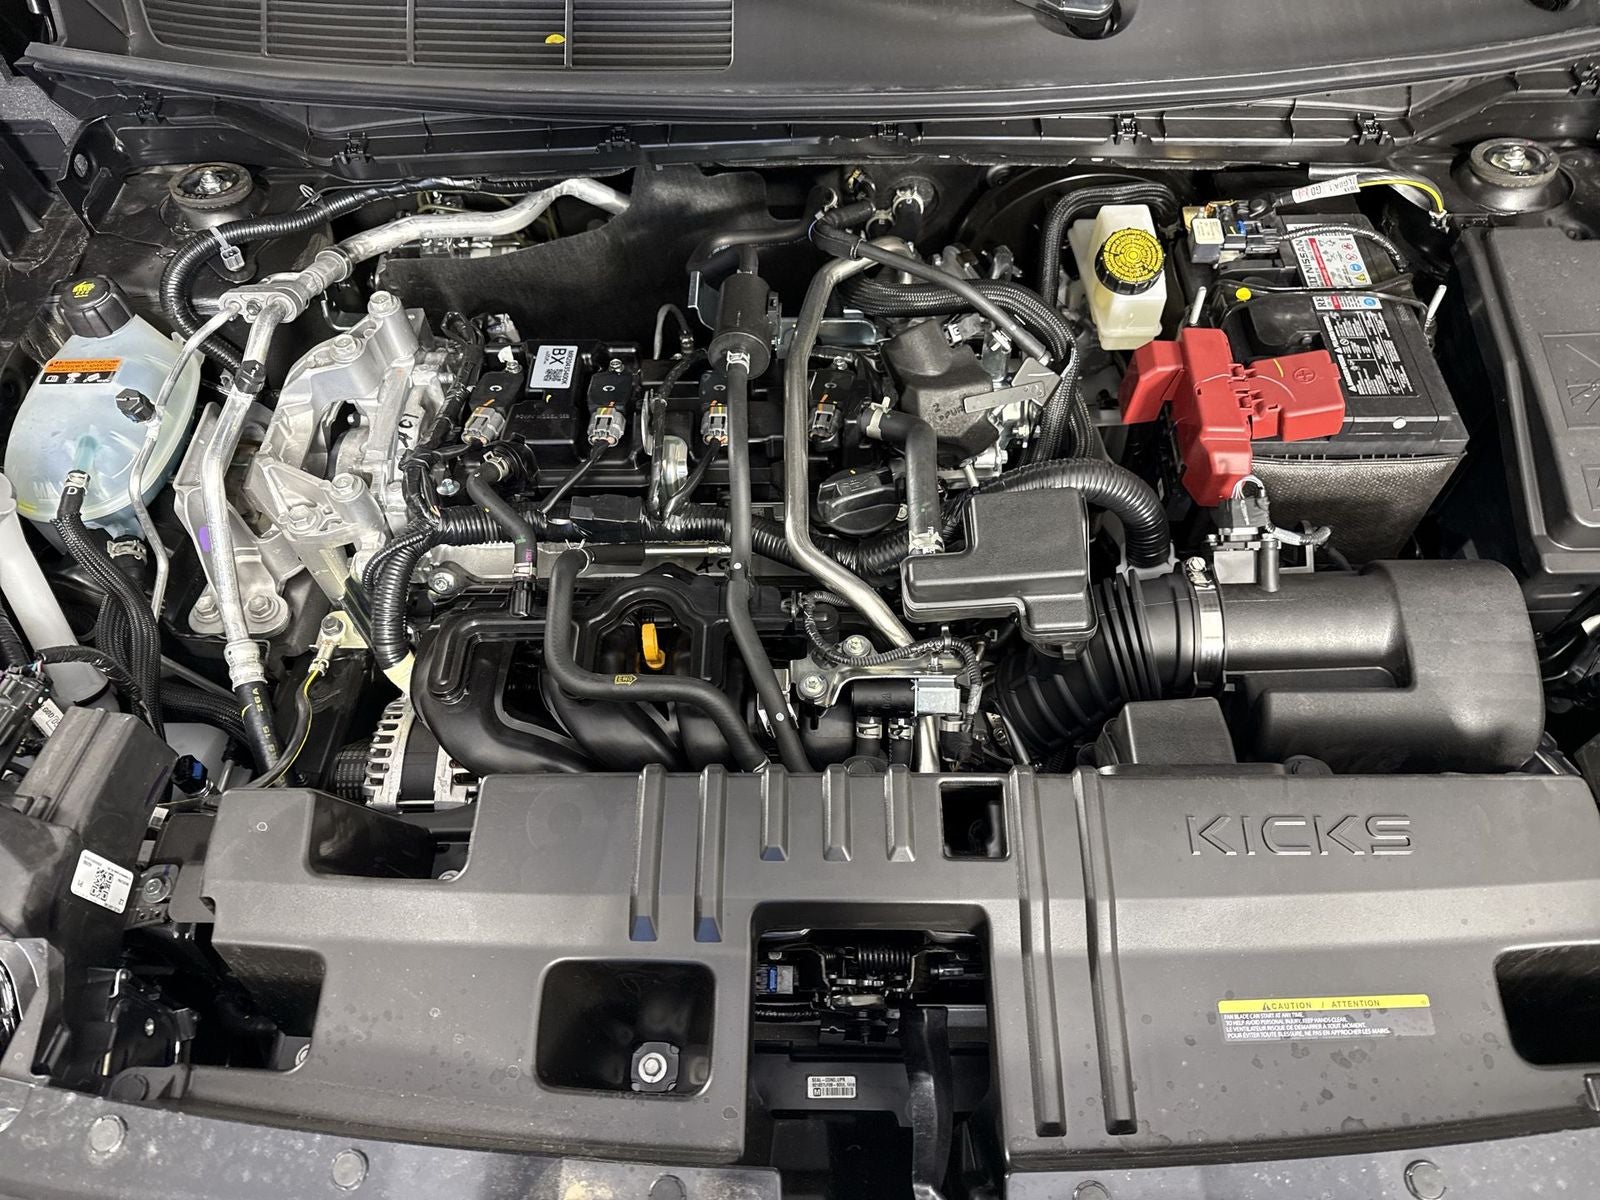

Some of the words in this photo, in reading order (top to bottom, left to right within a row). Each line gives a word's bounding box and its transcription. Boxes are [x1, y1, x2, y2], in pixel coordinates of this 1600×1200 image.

[1296, 240, 1315, 274] NISSAN
[549, 348, 566, 364] BX
[1186, 815, 1416, 856] KICKS
[1332, 1000, 1380, 1008] ATTENTION
